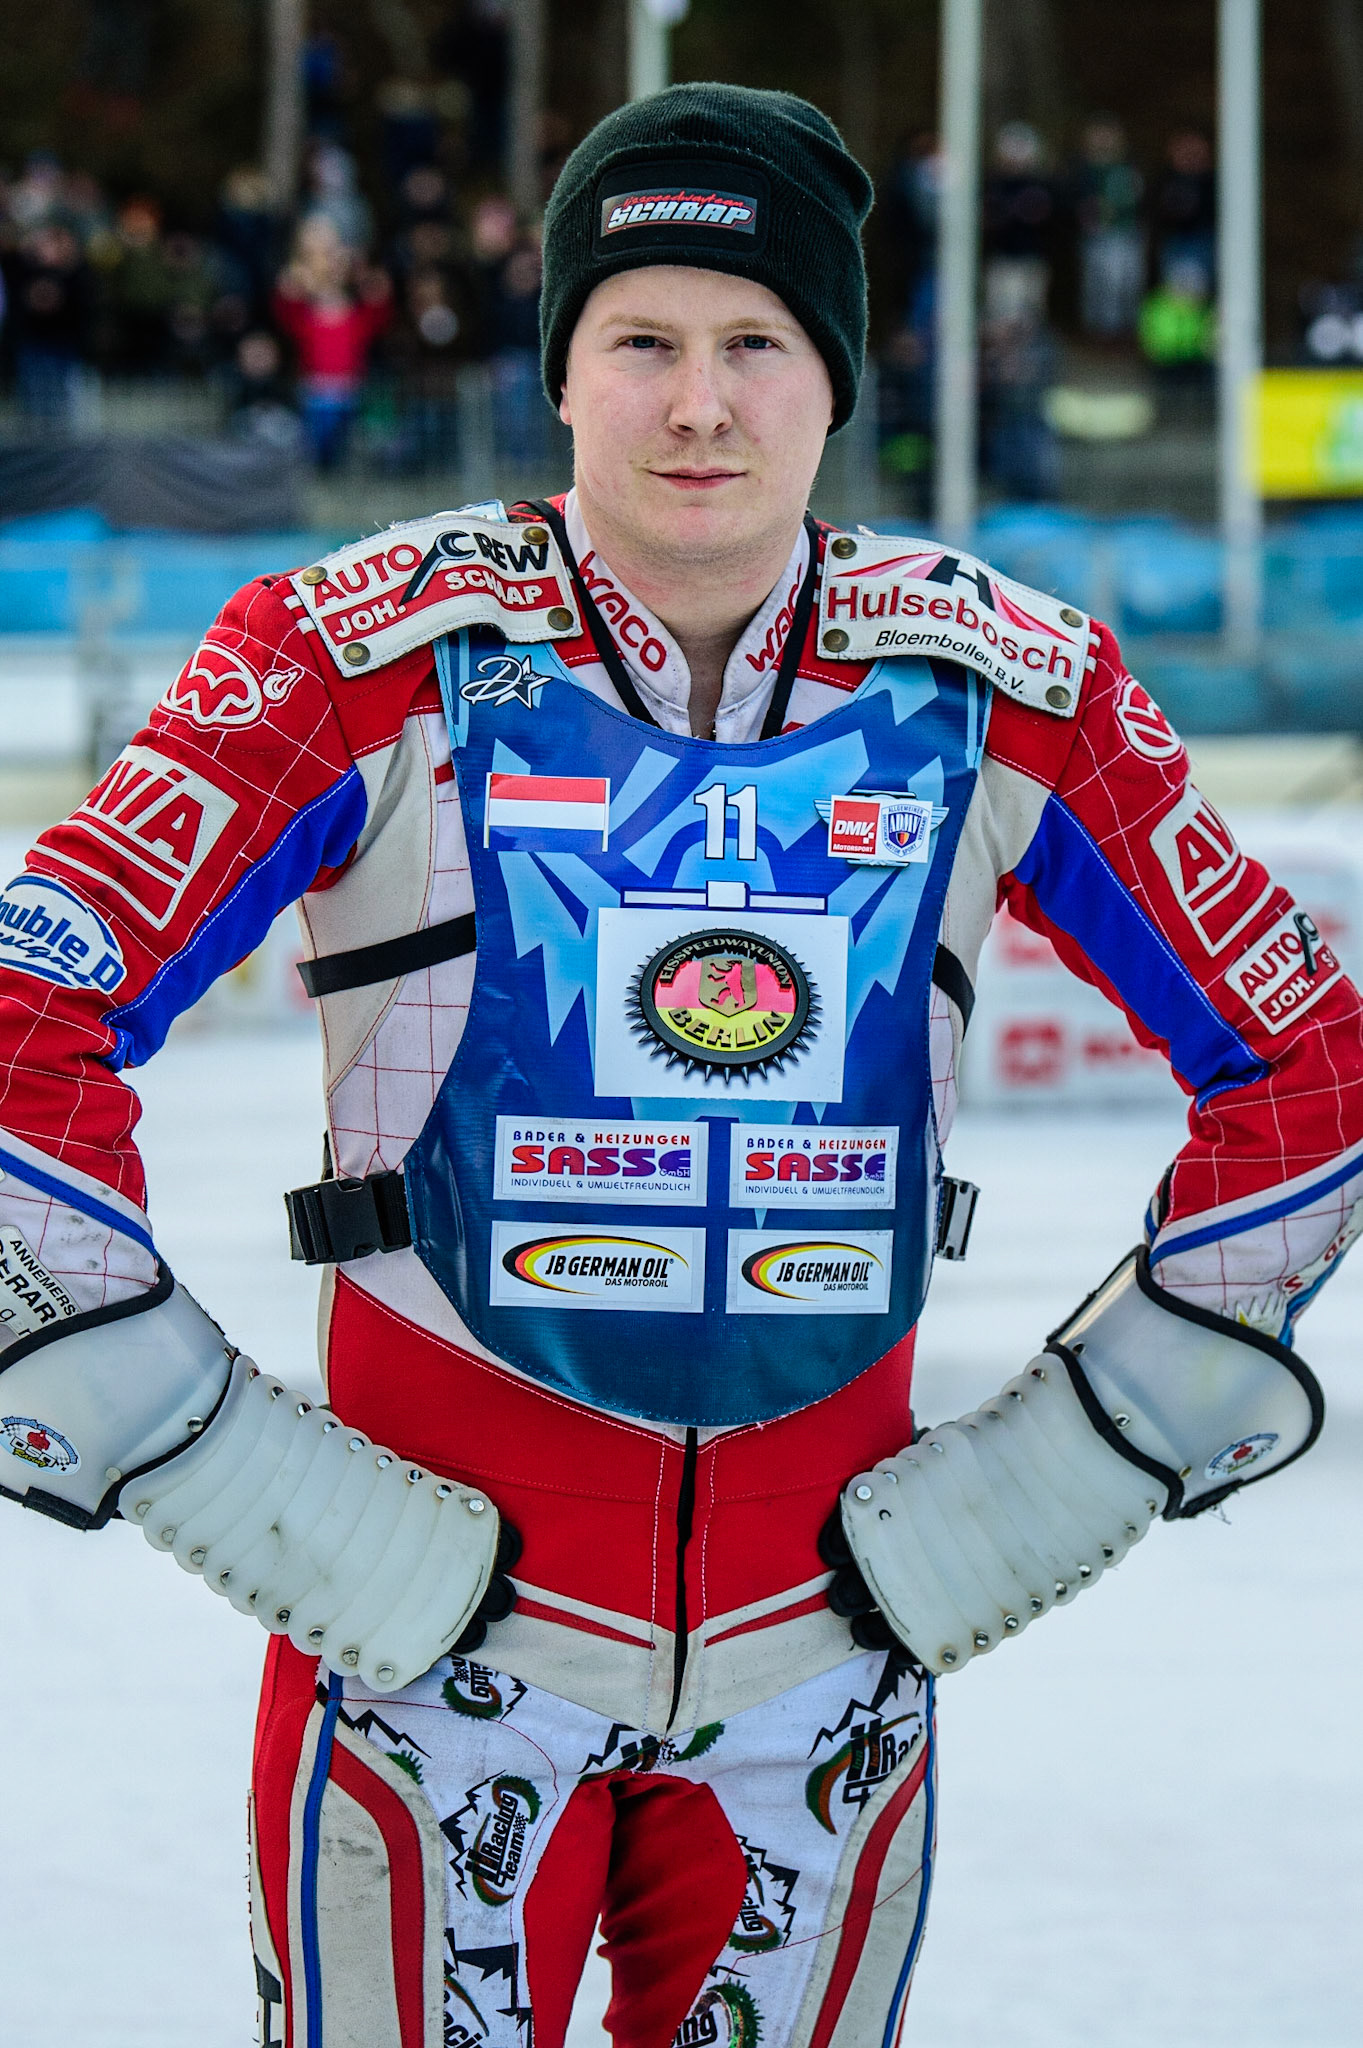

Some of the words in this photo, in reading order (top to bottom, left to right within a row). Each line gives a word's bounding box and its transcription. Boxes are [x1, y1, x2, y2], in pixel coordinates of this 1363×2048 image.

[608, 201, 752, 229] SCHAAP
[314, 543, 423, 609] AUTO
[335, 602, 406, 639] JOH.
[579, 550, 667, 672] WACO
[827, 583, 1073, 679] Hulsebosch
[875, 629, 993, 670] Bloembollen
[995, 667, 1025, 694] B.V.
[693, 783, 758, 861] 11
[833, 819, 876, 837] DMV
[89, 951, 125, 992] D
[659, 937, 793, 987] EISSPEEDWAYUNION
[1239, 932, 1303, 999] AUTO
[1270, 975, 1316, 1017] JOH.
[668, 1006, 786, 1048] BERLIN
[575, 1133, 585, 1143] &
[594, 1133, 690, 1145] HEIZUNGEN
[802, 1139, 811, 1149] &
[819, 1138, 886, 1150] HEIZUNGEN
[511, 1145, 691, 1178] SASSE
[745, 1152, 886, 1182] SASSE
[511, 1178, 572, 1188] INDIVIDUELL
[576, 1180, 584, 1188] &
[587, 1181, 691, 1191] UMWELTFREUNDLICH
[745, 1186, 798, 1194] INDIVIDUELL
[812, 1186, 885, 1195] UMWELTFREUNDLICH
[0, 1238, 57, 1324] ERAR
[9, 1240, 76, 1316] ANNEMERS
[545, 1255, 566, 1275] JB
[568, 1256, 640, 1278] GERMAN
[605, 1278, 622, 1287] DAS
[623, 1279, 669, 1288] MOTOROIL
[776, 1262, 795, 1282] JB
[796, 1262, 850, 1283] GERMAN
[823, 1283, 836, 1291] DAS
[837, 1283, 869, 1291] MOTOROIL
[480, 1792, 519, 1859] Racing
